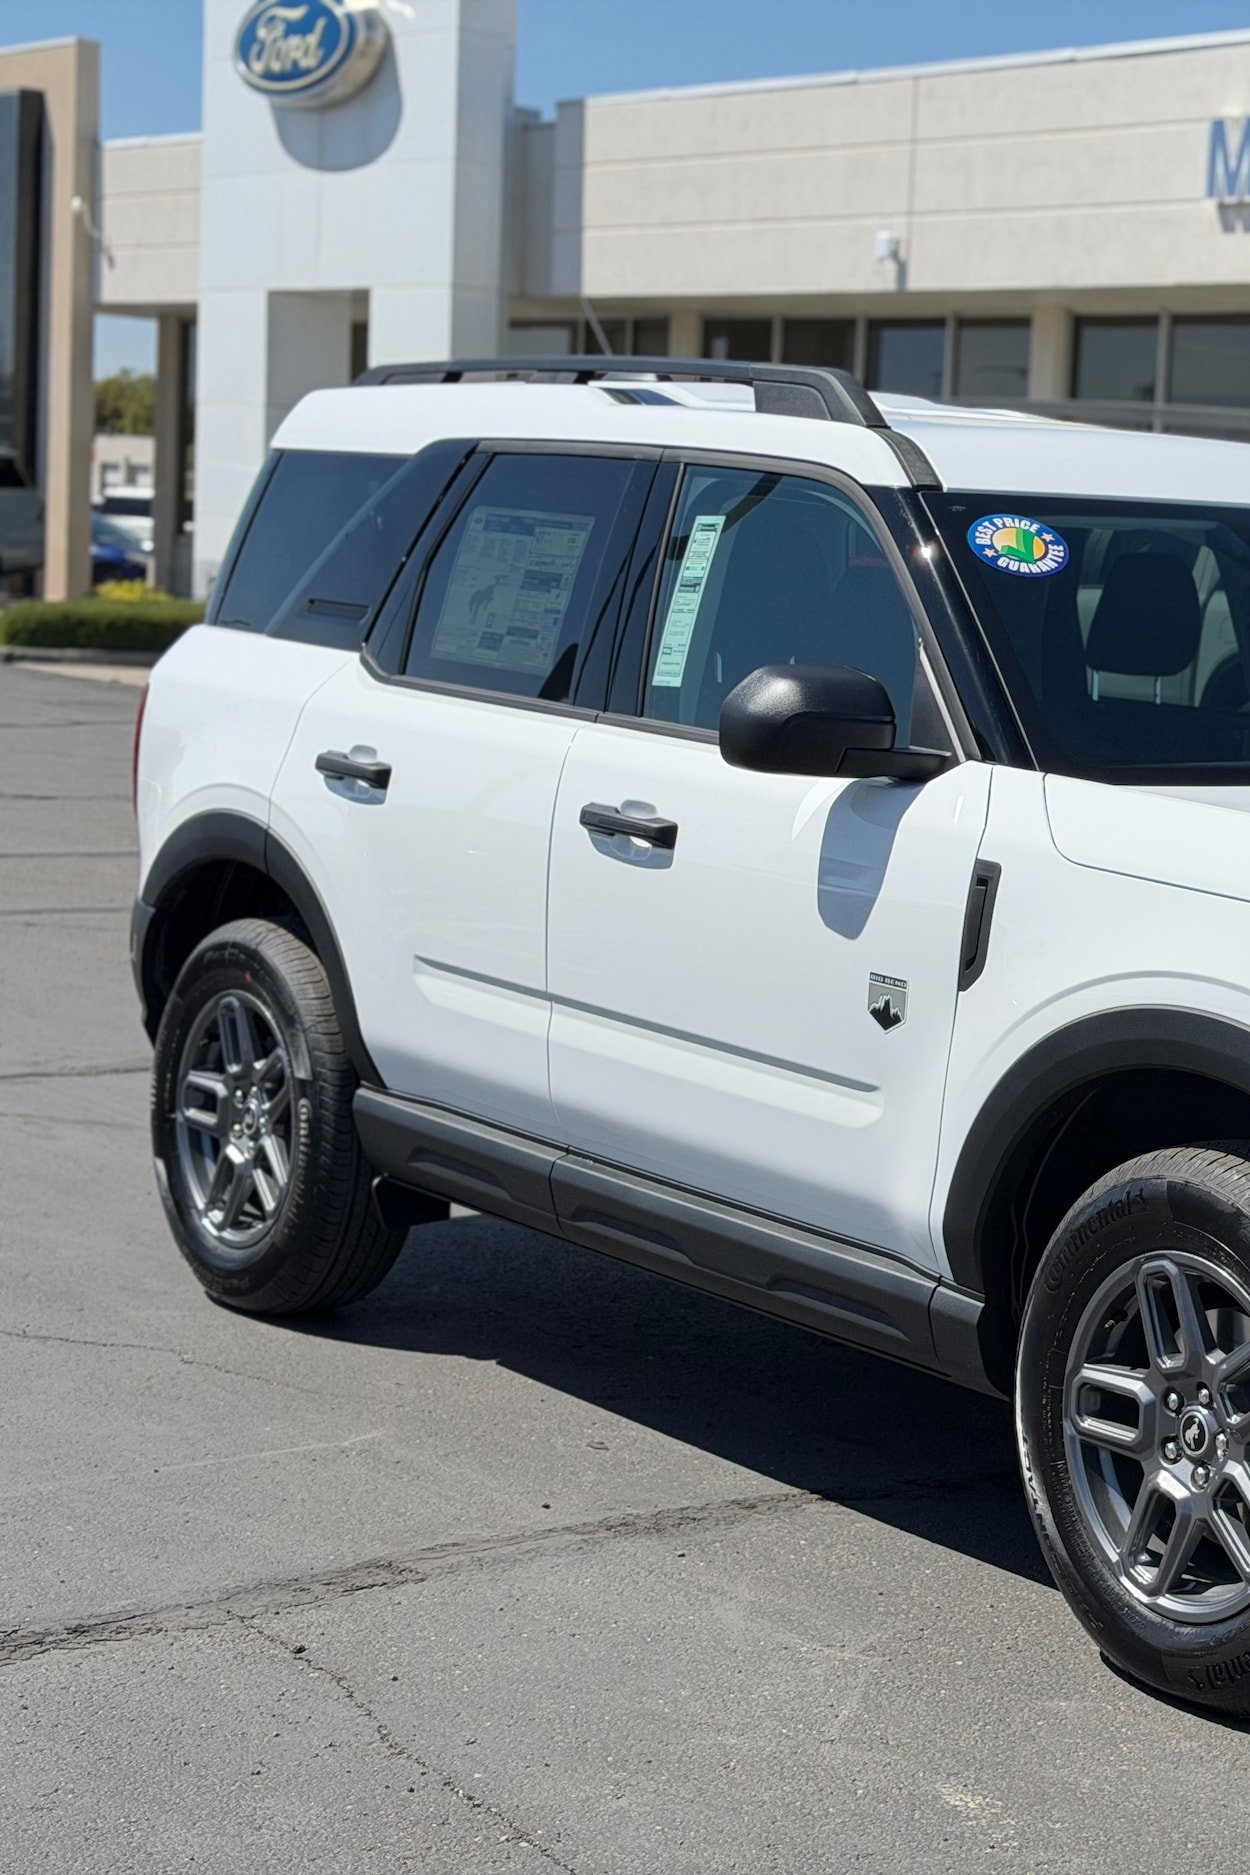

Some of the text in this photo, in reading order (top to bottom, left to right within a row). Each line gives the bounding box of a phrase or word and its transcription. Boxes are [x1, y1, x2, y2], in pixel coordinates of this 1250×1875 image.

[248, 4, 328, 76] Ford
[975, 517, 1040, 545] BEST PRICE
[997, 544, 1064, 573] GUARANTEE
[884, 978, 907, 988] BEND
[1044, 1190, 1133, 1292] Continental
